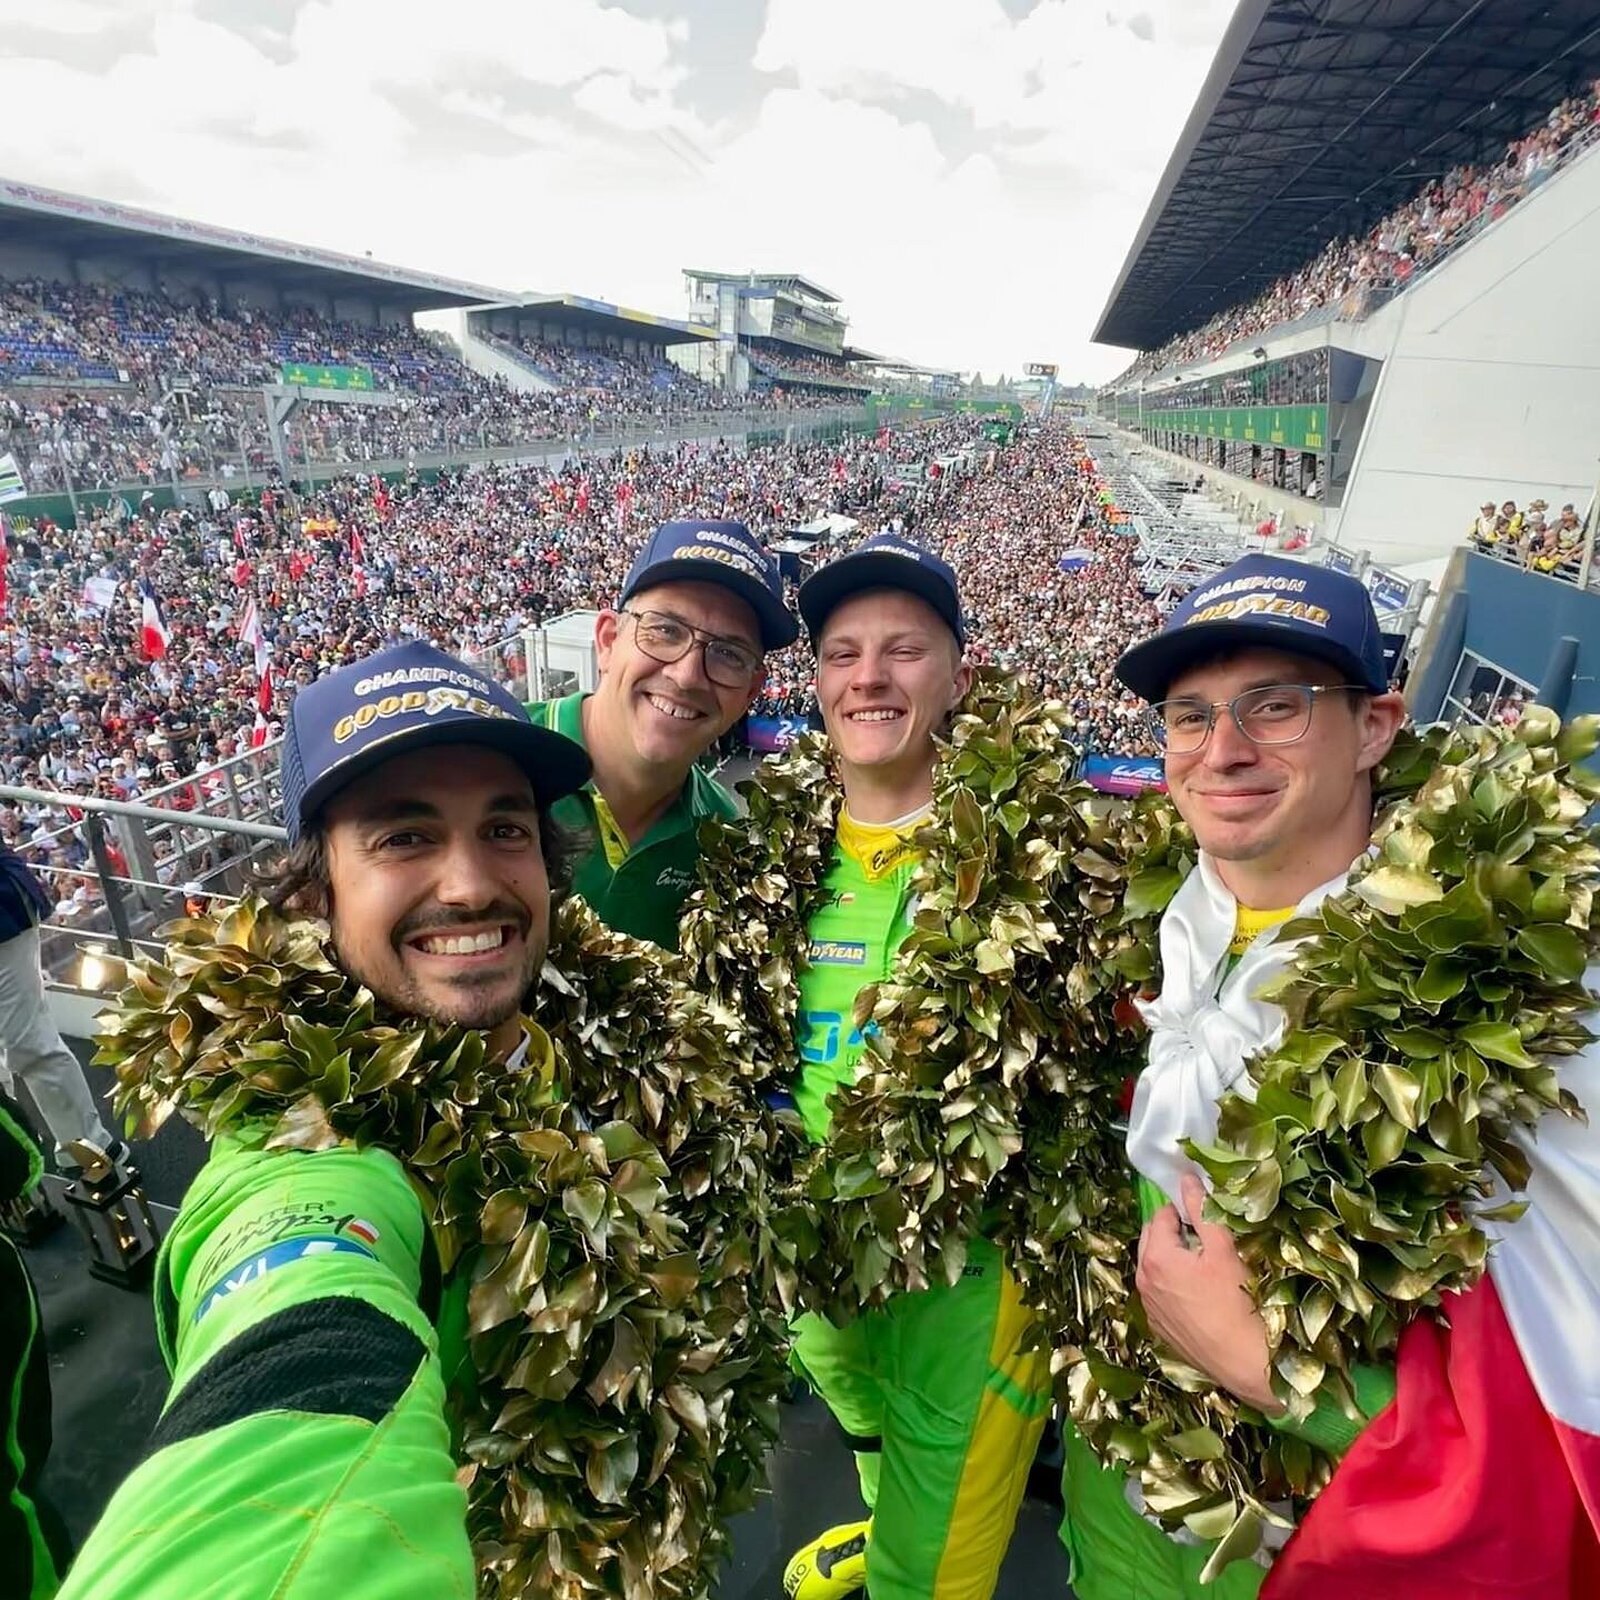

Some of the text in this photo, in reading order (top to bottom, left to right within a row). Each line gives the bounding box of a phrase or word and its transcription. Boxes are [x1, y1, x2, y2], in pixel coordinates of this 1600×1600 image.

[696, 530, 768, 572] CHAMPION
[1193, 576, 1307, 608] CHAMPION
[354, 667, 490, 696] CHAMPION
